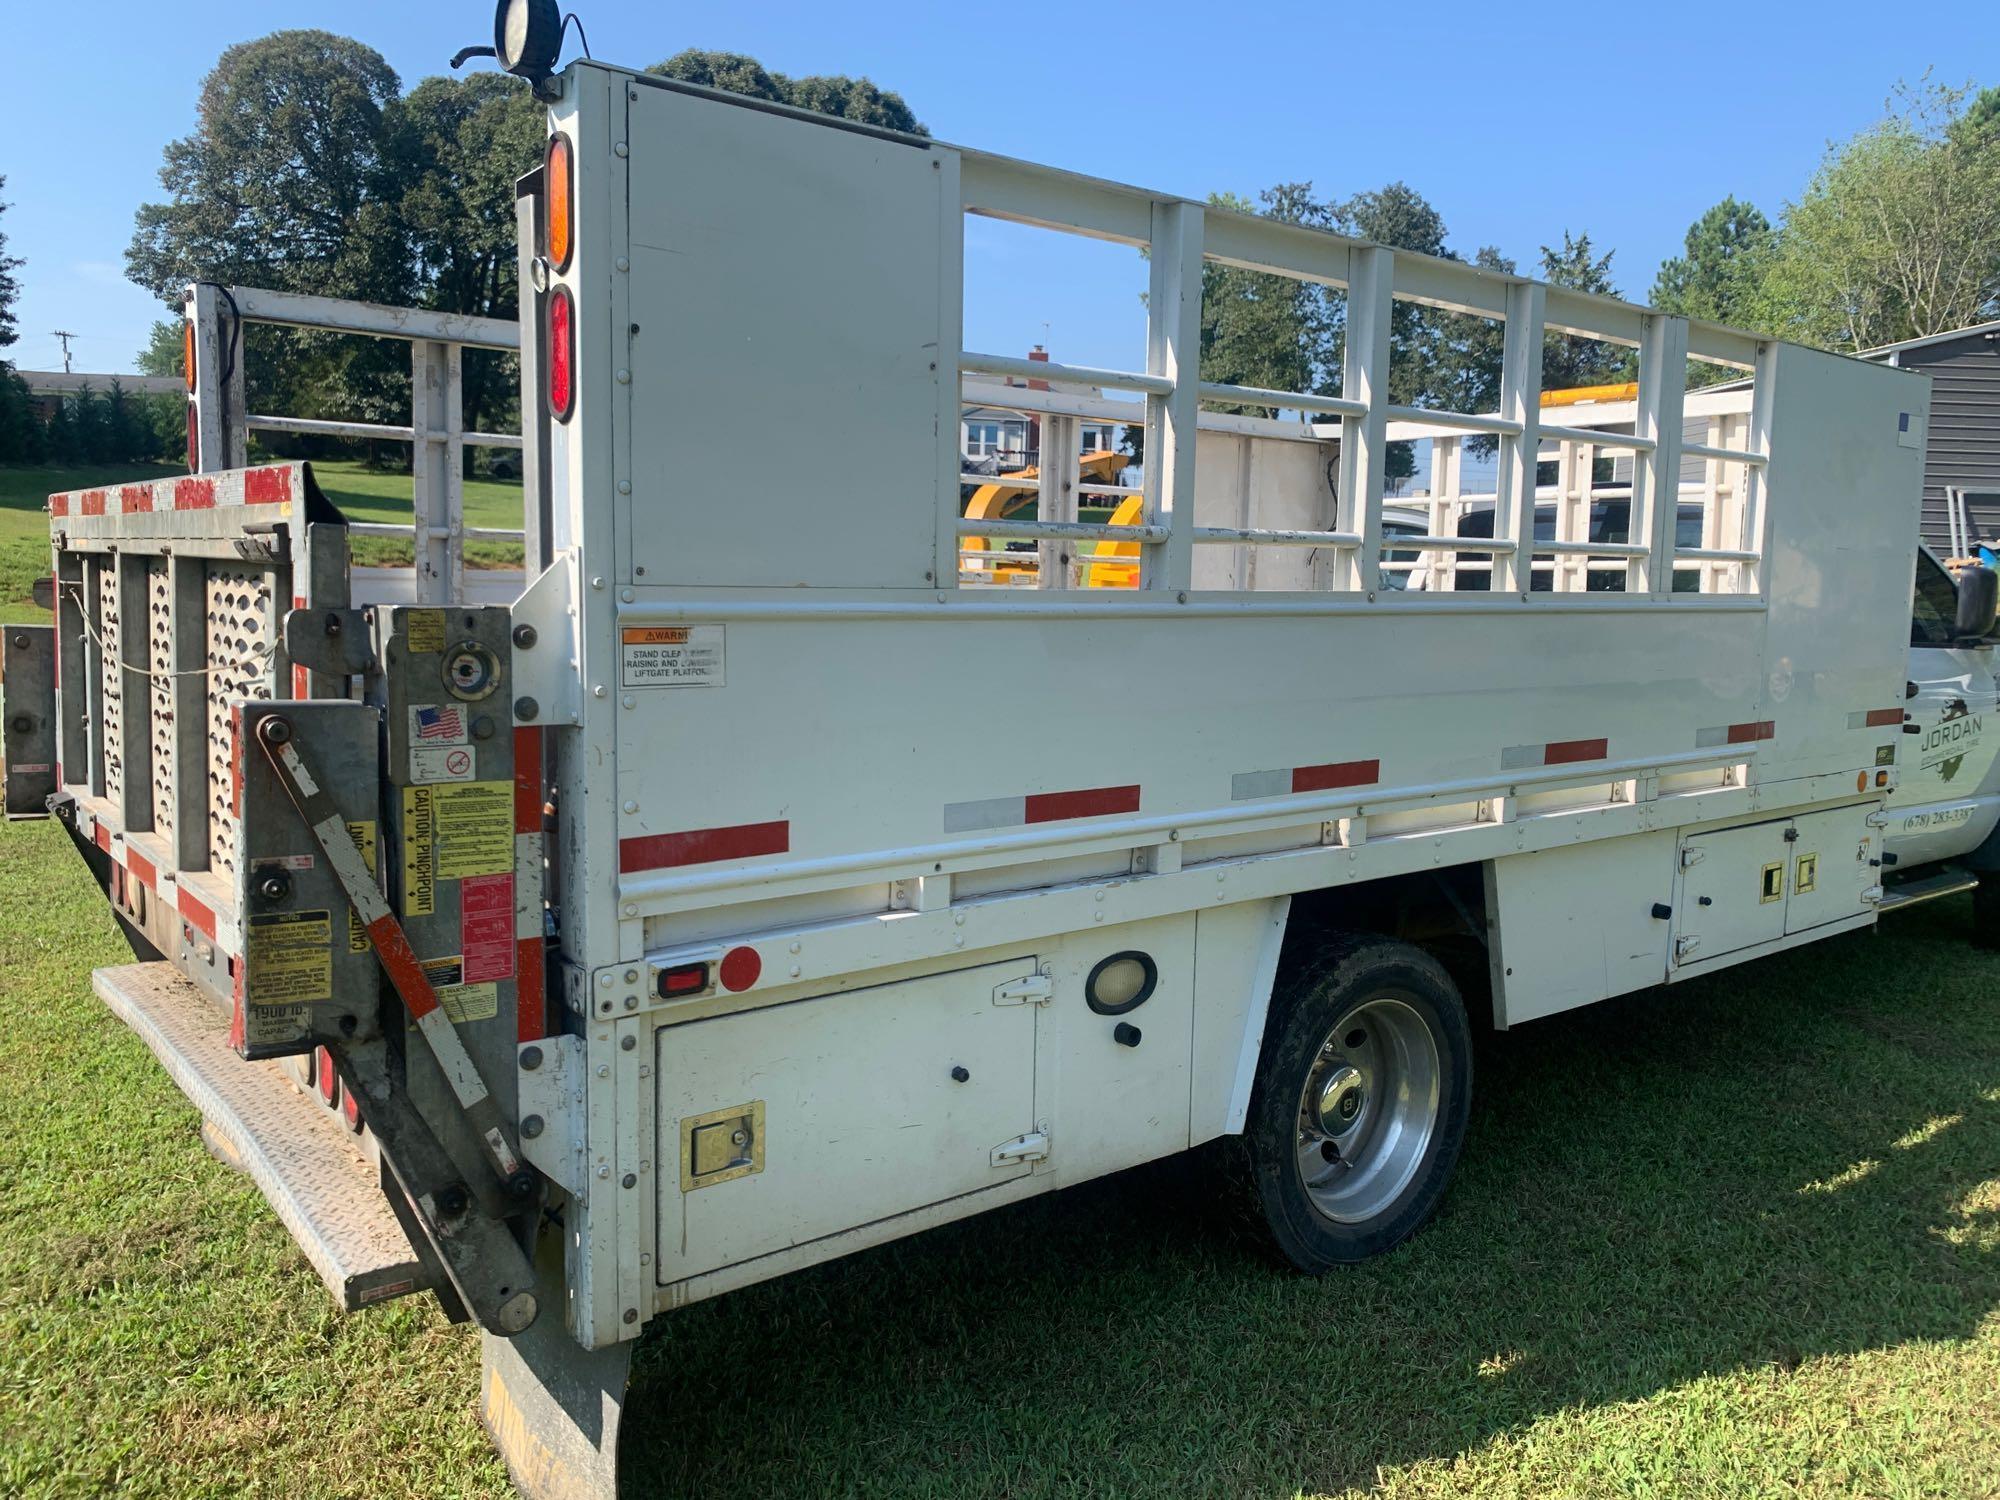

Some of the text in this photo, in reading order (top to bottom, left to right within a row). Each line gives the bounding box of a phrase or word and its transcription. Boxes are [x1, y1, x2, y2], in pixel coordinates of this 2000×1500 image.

[655, 631, 689, 641] WARNI
[633, 650, 659, 659] STAND
[661, 649, 682, 659] CLEA
[626, 660, 658, 669] RAISING
[661, 659, 678, 668] AND
[634, 668, 706, 678] LIFTGATE PLATFOR
[1921, 715, 1982, 752] JORDAN
[414, 789, 431, 843] CAUTION:
[1903, 813, 1930, 831] (678)
[416, 845, 432, 911] PINCHPOINT
[279, 914, 301, 922] NOTICE
[262, 1017, 297, 1026] MAXIMUM
[257, 1026, 289, 1036] CAPAC
